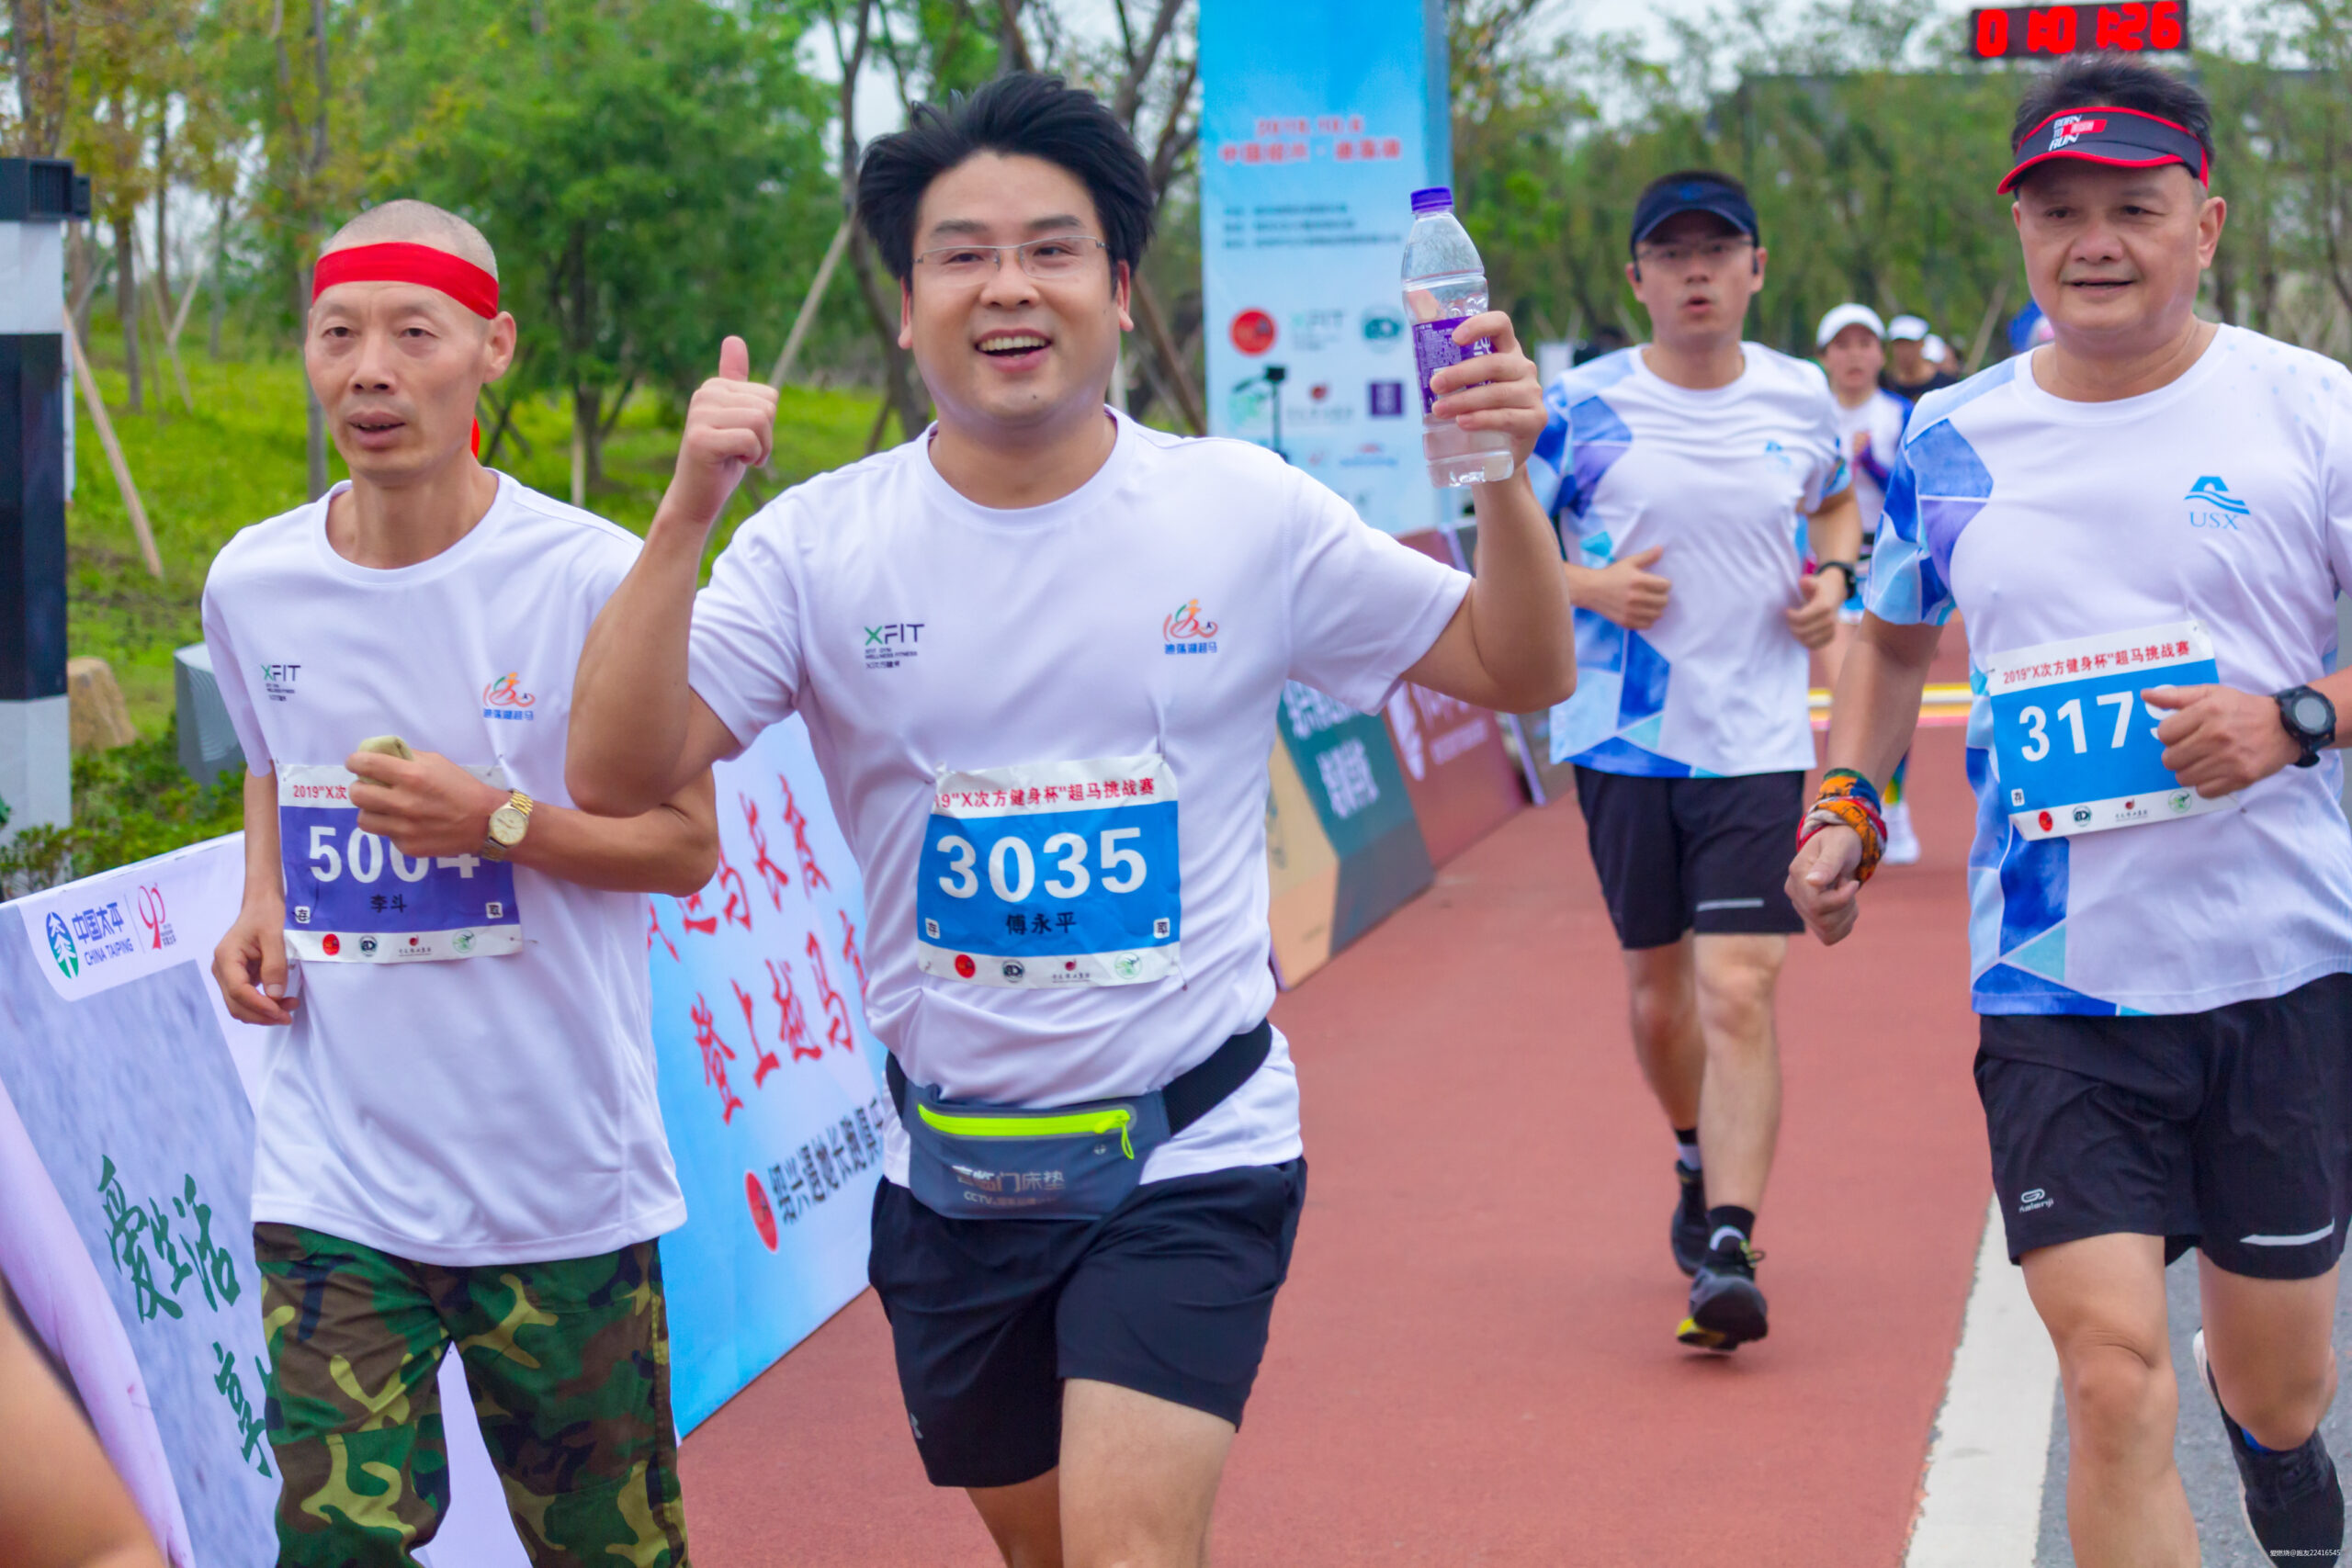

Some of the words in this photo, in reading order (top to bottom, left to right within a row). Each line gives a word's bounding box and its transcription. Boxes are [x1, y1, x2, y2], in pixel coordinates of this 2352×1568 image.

[2189, 512, 2240, 530] USX
[865, 624, 924, 645] XFIT
[261, 665, 301, 681] XFIT
[935, 827, 1148, 902] 3035
[370, 894, 408, 913] 李斗
[72, 902, 124, 944] 中国太平
[85, 948, 107, 966] CHINA
[106, 937, 134, 959] TAIPING
[97, 1154, 241, 1324] 爱生活
[213, 1341, 274, 1479] 享
